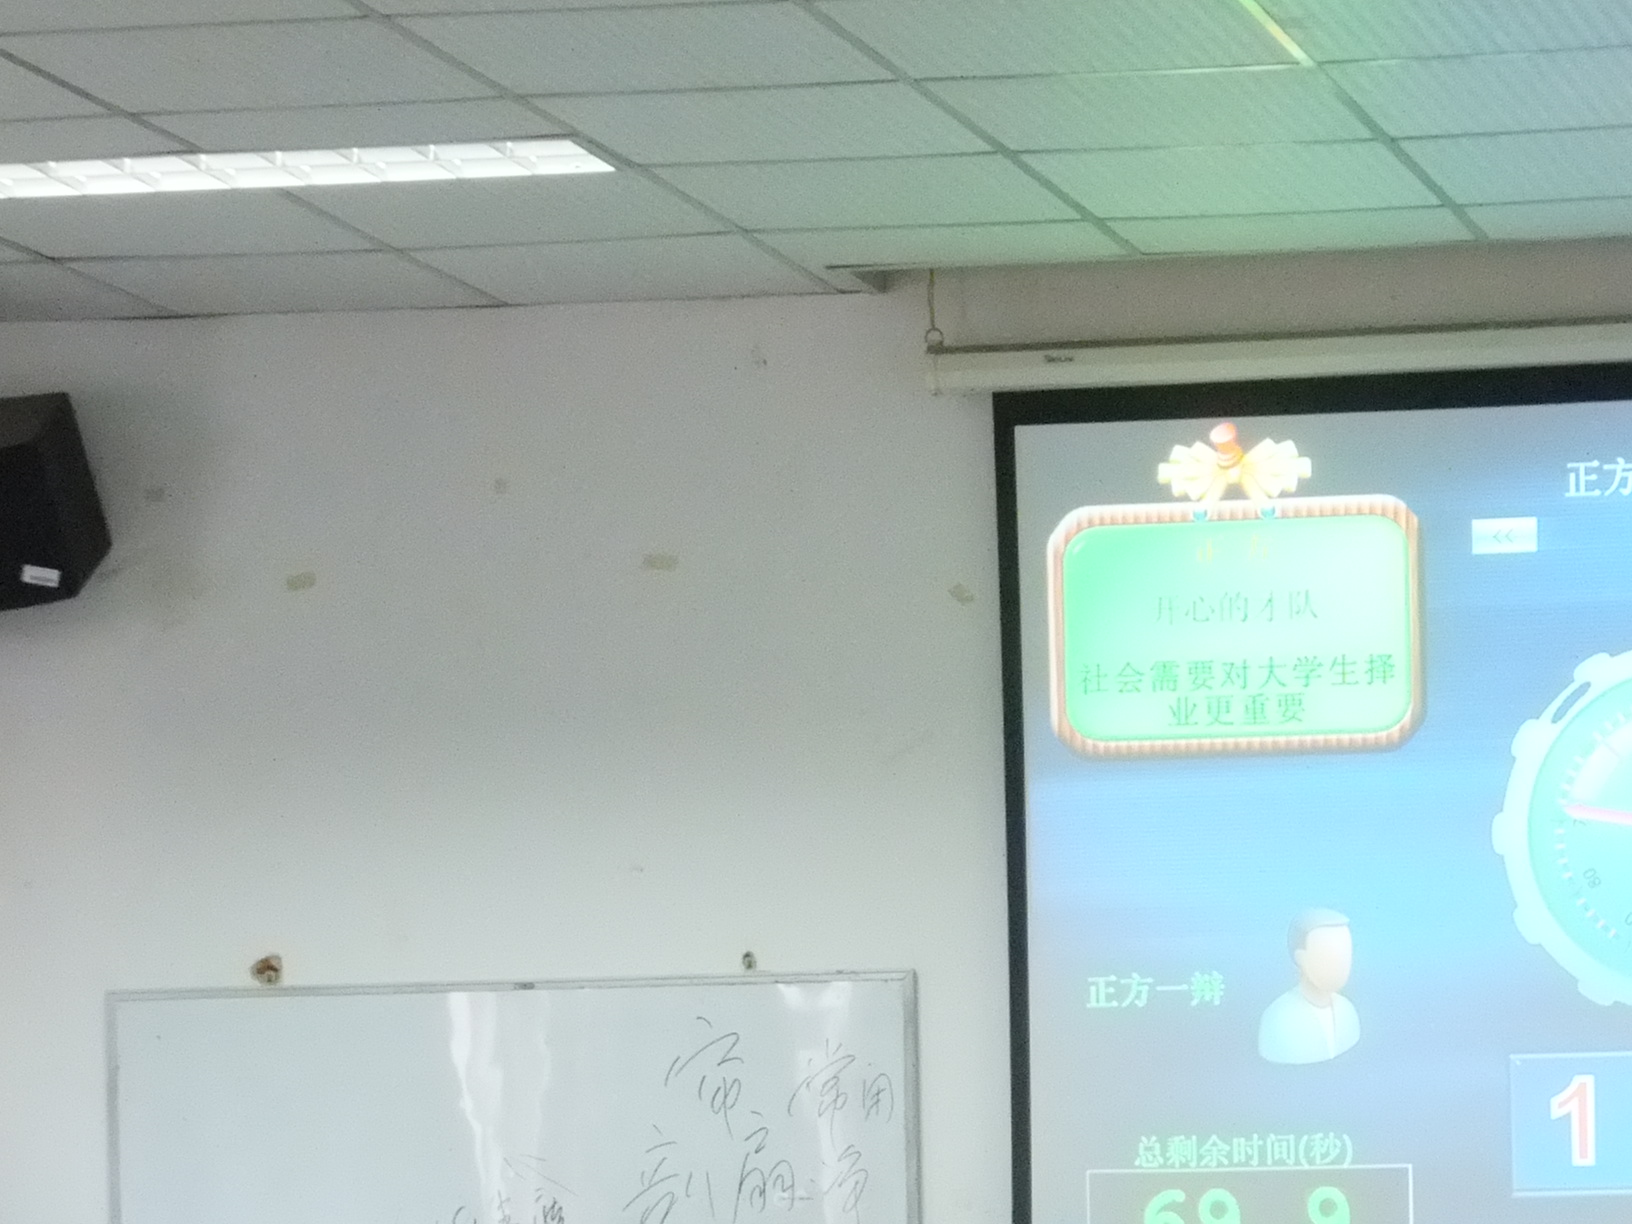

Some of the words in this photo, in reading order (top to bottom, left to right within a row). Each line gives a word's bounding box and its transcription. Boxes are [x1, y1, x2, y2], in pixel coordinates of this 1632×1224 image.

[1080, 653, 1397, 694] 社会需要对大学生择
[1167, 692, 1307, 728] 业更重要
[1086, 970, 1226, 1010] 正方一辩
